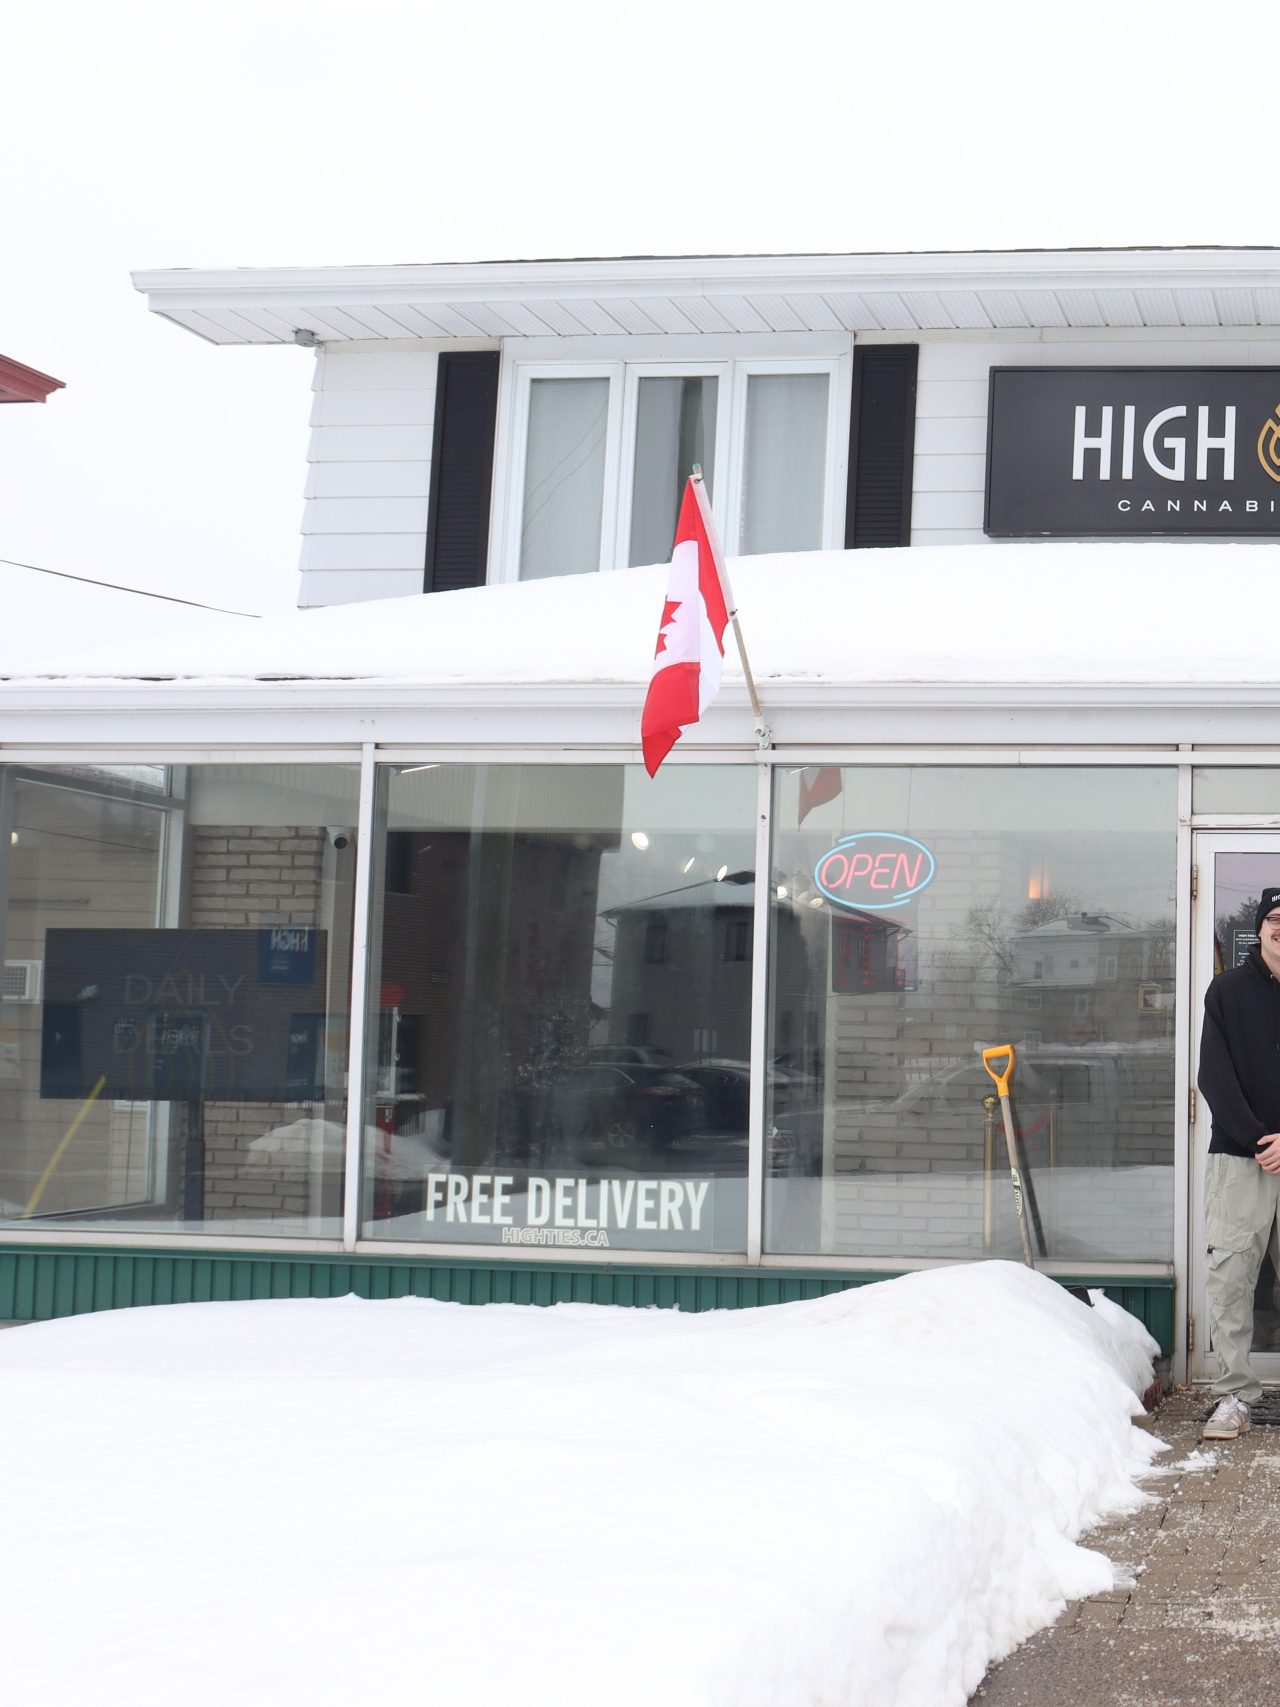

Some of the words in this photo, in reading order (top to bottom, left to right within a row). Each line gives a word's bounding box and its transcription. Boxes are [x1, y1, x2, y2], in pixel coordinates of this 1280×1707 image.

[1072, 405, 1236, 481] HIGH
[821, 852, 923, 889] OPEN
[123, 974, 248, 1005] DAILY
[425, 1173, 514, 1225] FREE
[527, 1176, 710, 1231] DELIVERY
[502, 1227, 609, 1247] HIGHTIES.CA
